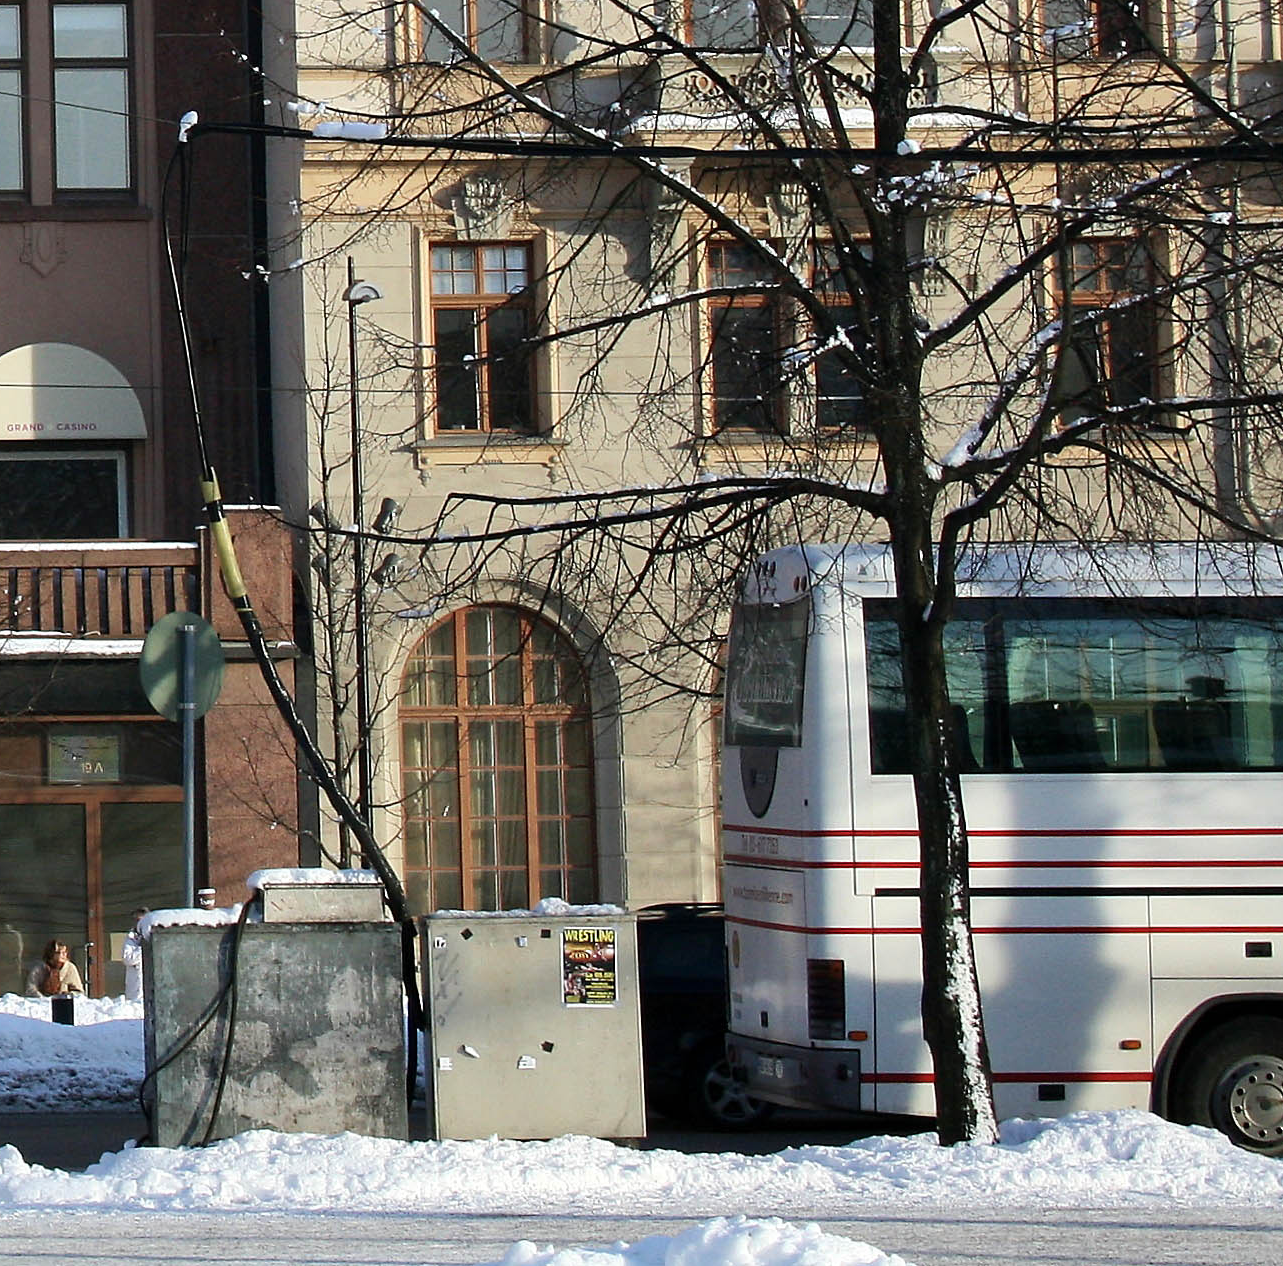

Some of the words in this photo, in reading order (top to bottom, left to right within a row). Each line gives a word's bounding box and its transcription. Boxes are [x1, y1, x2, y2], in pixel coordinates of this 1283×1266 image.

[7, 422, 45, 432] GRAND
[56, 421, 98, 431] CASINO
[564, 929, 615, 943] WRESTLING
